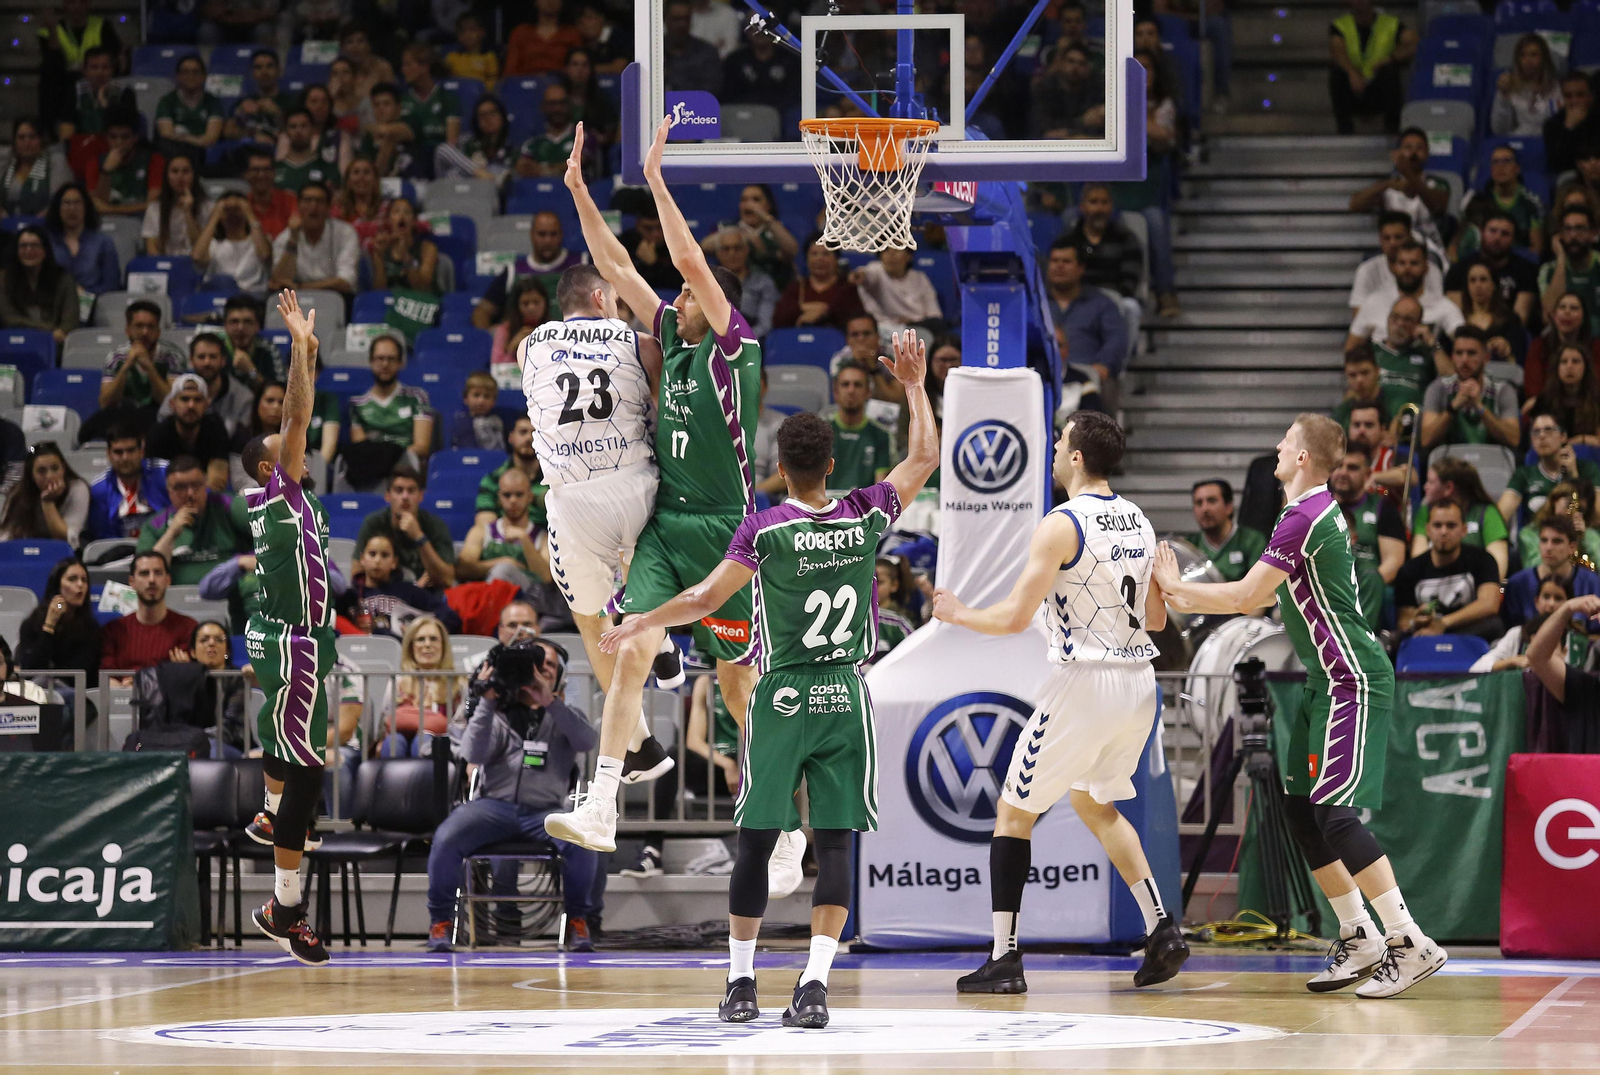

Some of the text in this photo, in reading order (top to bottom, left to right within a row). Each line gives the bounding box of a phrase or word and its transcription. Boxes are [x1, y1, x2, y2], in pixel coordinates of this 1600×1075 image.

[680, 106, 695, 118] liga
[681, 116, 718, 125] endesa
[529, 328, 632, 347] BURJANADZE
[986, 302, 1001, 367] MONDO
[555, 368, 613, 425] 23
[671, 429, 690, 460] 17
[945, 501, 1033, 514] Málaga Wagen
[794, 525, 865, 552] ROBERTS
[801, 584, 858, 650] 22
[808, 694, 852, 705] DEL SOL
[809, 683, 850, 695] COSTA
[808, 704, 853, 715] MÁLAGA
[0, 842, 157, 918] icaja
[868, 862, 1100, 892] Málaga agen
